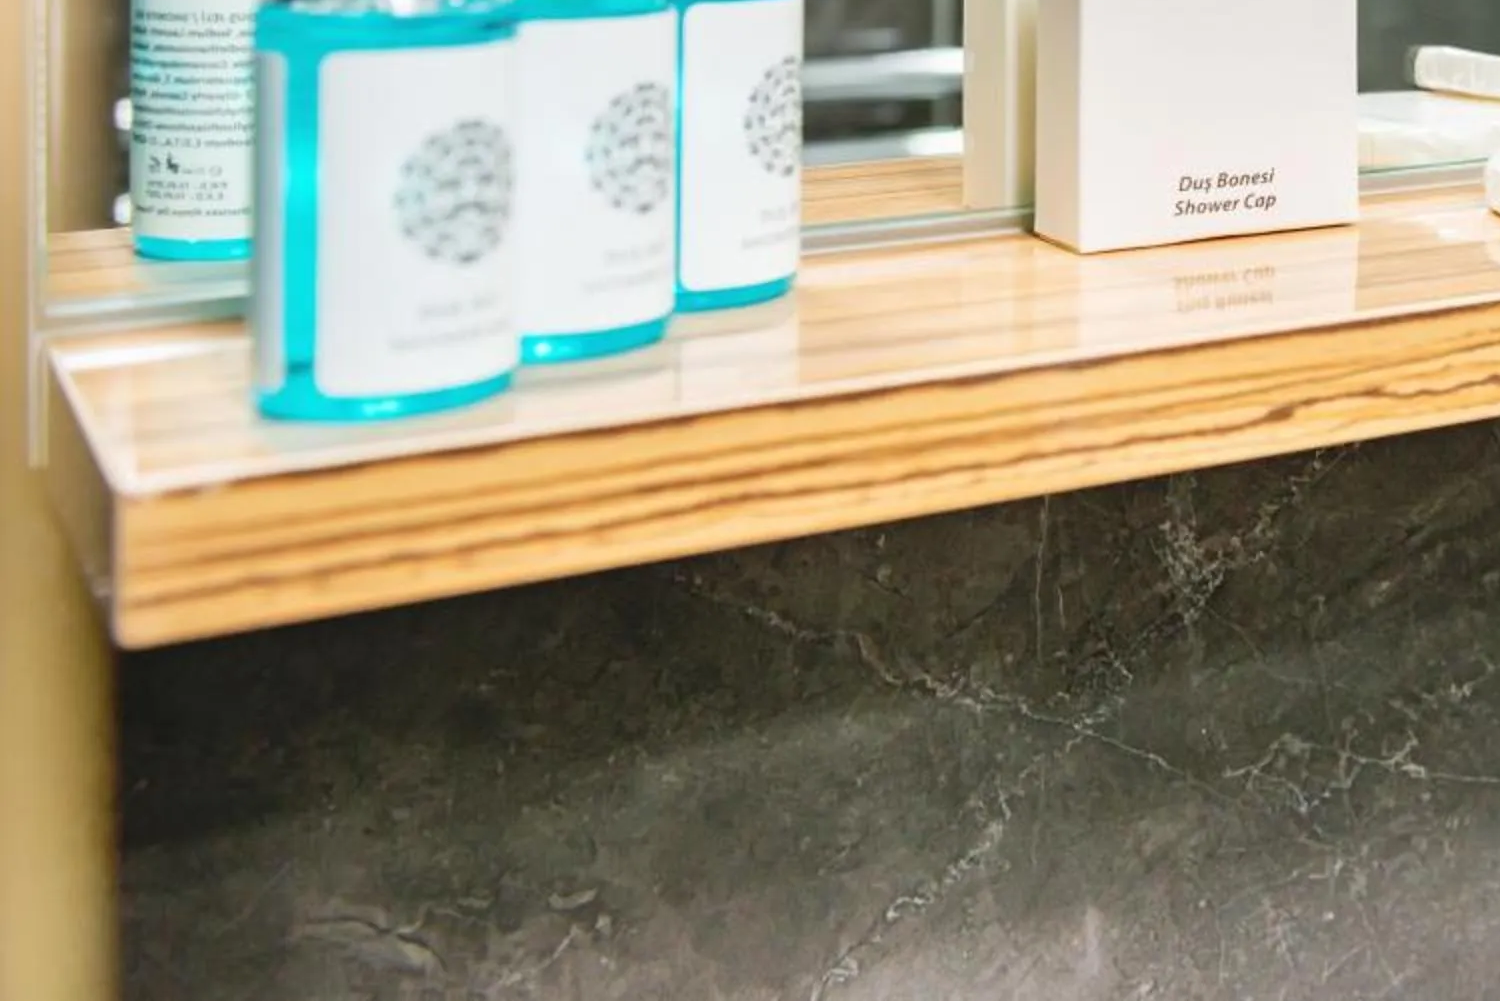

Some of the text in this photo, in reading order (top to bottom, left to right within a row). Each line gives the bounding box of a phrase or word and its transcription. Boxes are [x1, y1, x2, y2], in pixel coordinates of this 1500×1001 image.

[1179, 167, 1275, 193] Duş Bonesi
[1174, 192, 1277, 216] Shower Cap
